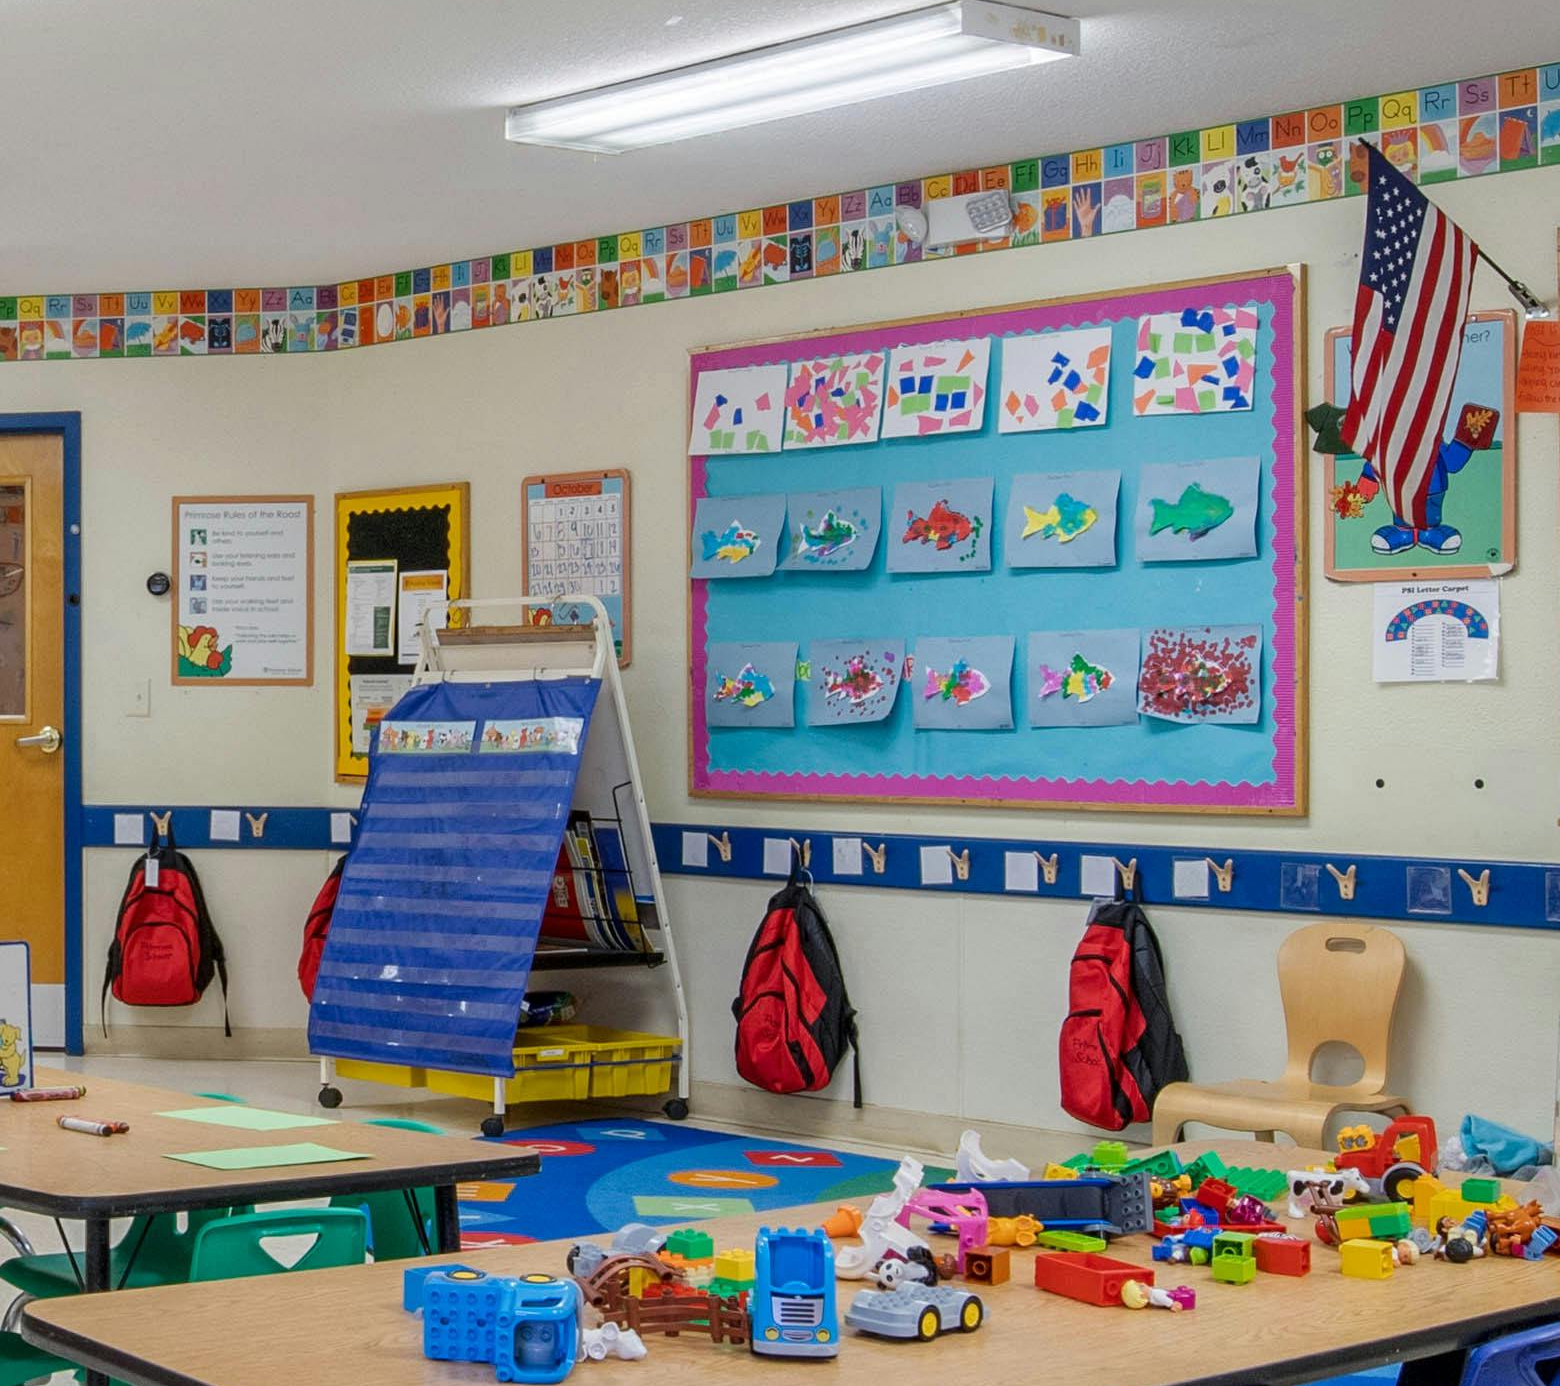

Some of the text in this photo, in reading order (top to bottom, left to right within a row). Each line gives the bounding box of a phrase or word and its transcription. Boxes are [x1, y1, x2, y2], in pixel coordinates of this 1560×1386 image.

[1505, 75, 1532, 97] Tt
[553, 482, 594, 496] October
[185, 509, 302, 519] Primrose Rules of the Roost
[1442, 585, 1469, 593] Carpet
